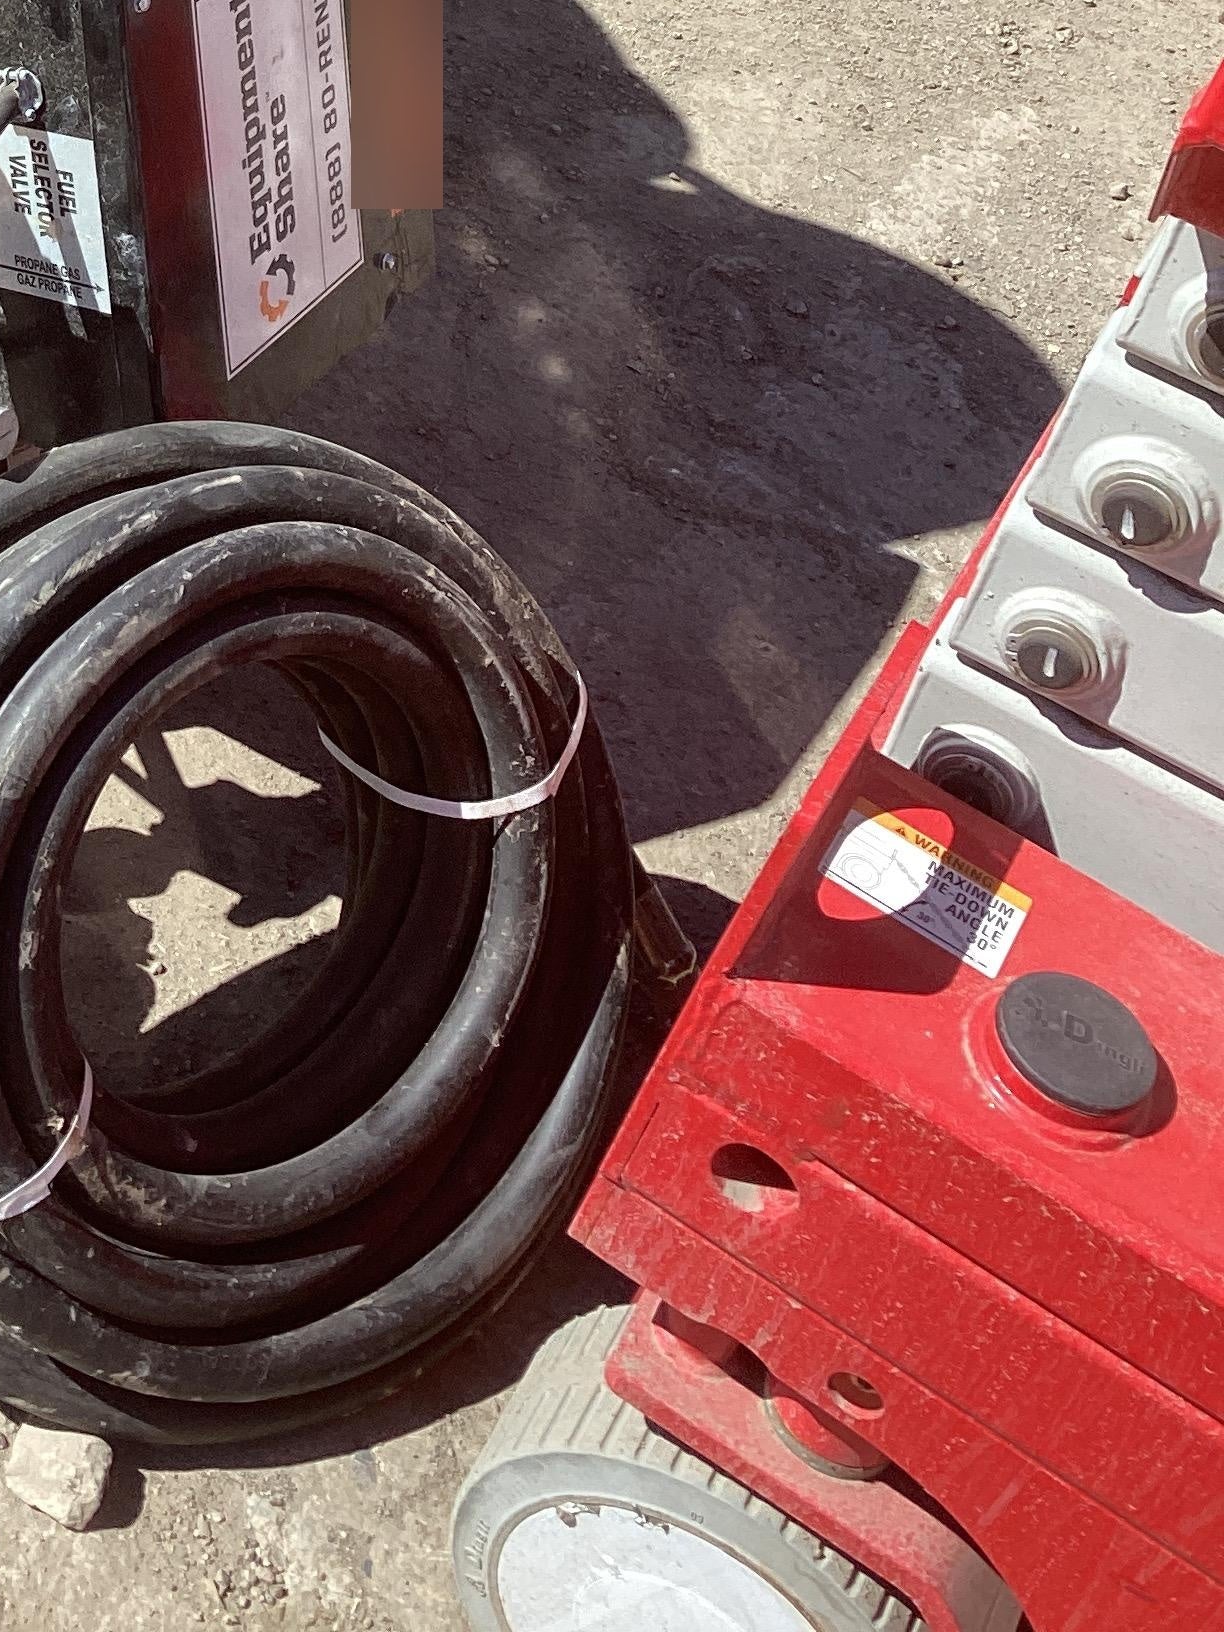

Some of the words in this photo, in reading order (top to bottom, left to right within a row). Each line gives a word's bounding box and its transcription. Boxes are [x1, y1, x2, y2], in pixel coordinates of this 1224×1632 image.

[9, 155, 32, 216] VALVE
[30, 138, 55, 237] SELECTOR
[56, 169, 78, 218] FUEL
[270, 94, 296, 243] Share
[325, 141, 348, 243] (888)
[14, 254, 58, 276] PROPANE
[59, 266, 81, 281] GAS
[16, 273, 36, 288] GAZ
[38, 277, 83, 299] PROPANE
[914, 834, 994, 890] WARNING
[927, 860, 1015, 919] MAXIMUM
[925, 872, 1009, 931] TIE-DOWN
[945, 904, 1004, 944] ANGLE
